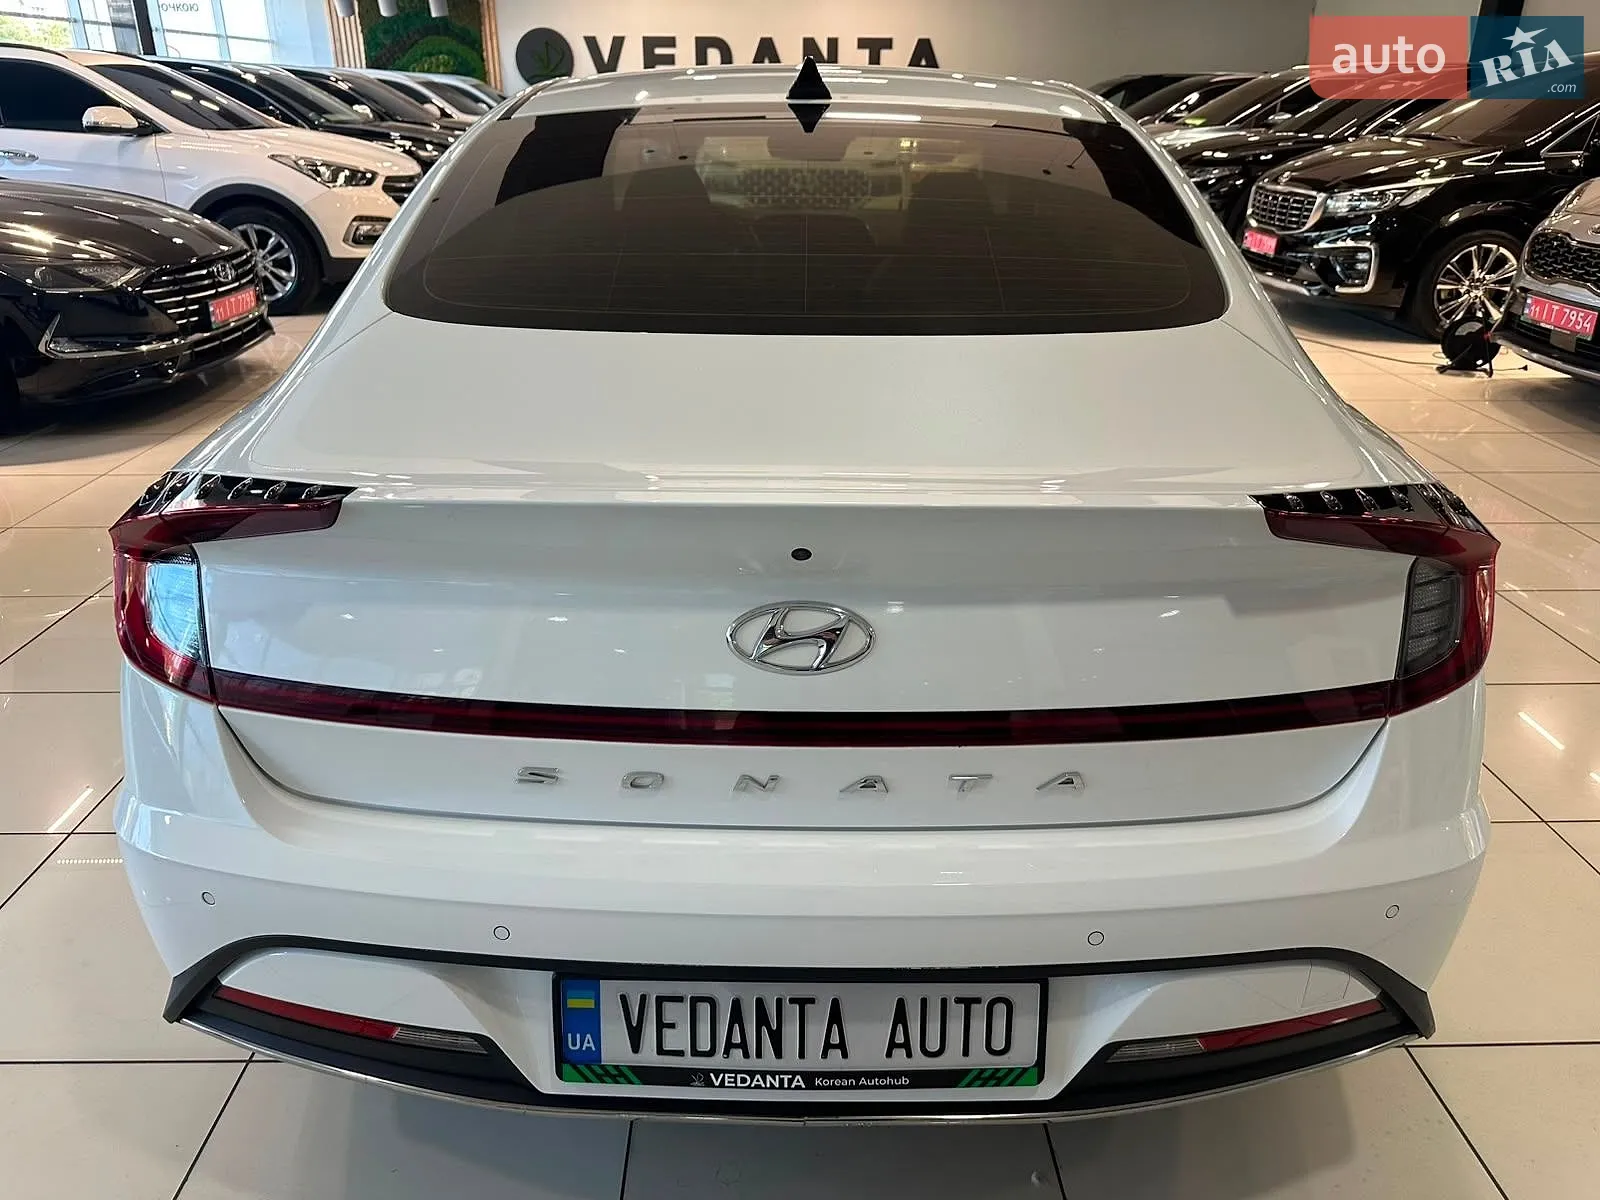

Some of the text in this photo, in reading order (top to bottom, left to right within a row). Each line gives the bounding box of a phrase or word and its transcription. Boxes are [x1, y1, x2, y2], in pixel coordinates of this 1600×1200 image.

[583, 35, 940, 73] VEDANTA
[1560, 307, 1593, 333] 7954
[516, 766, 1086, 796] SONATA
[618, 993, 1014, 1060] VEDANTA AUTO
[567, 1033, 596, 1052] UA
[709, 1072, 910, 1089] VEDANTA Korean Autohub
